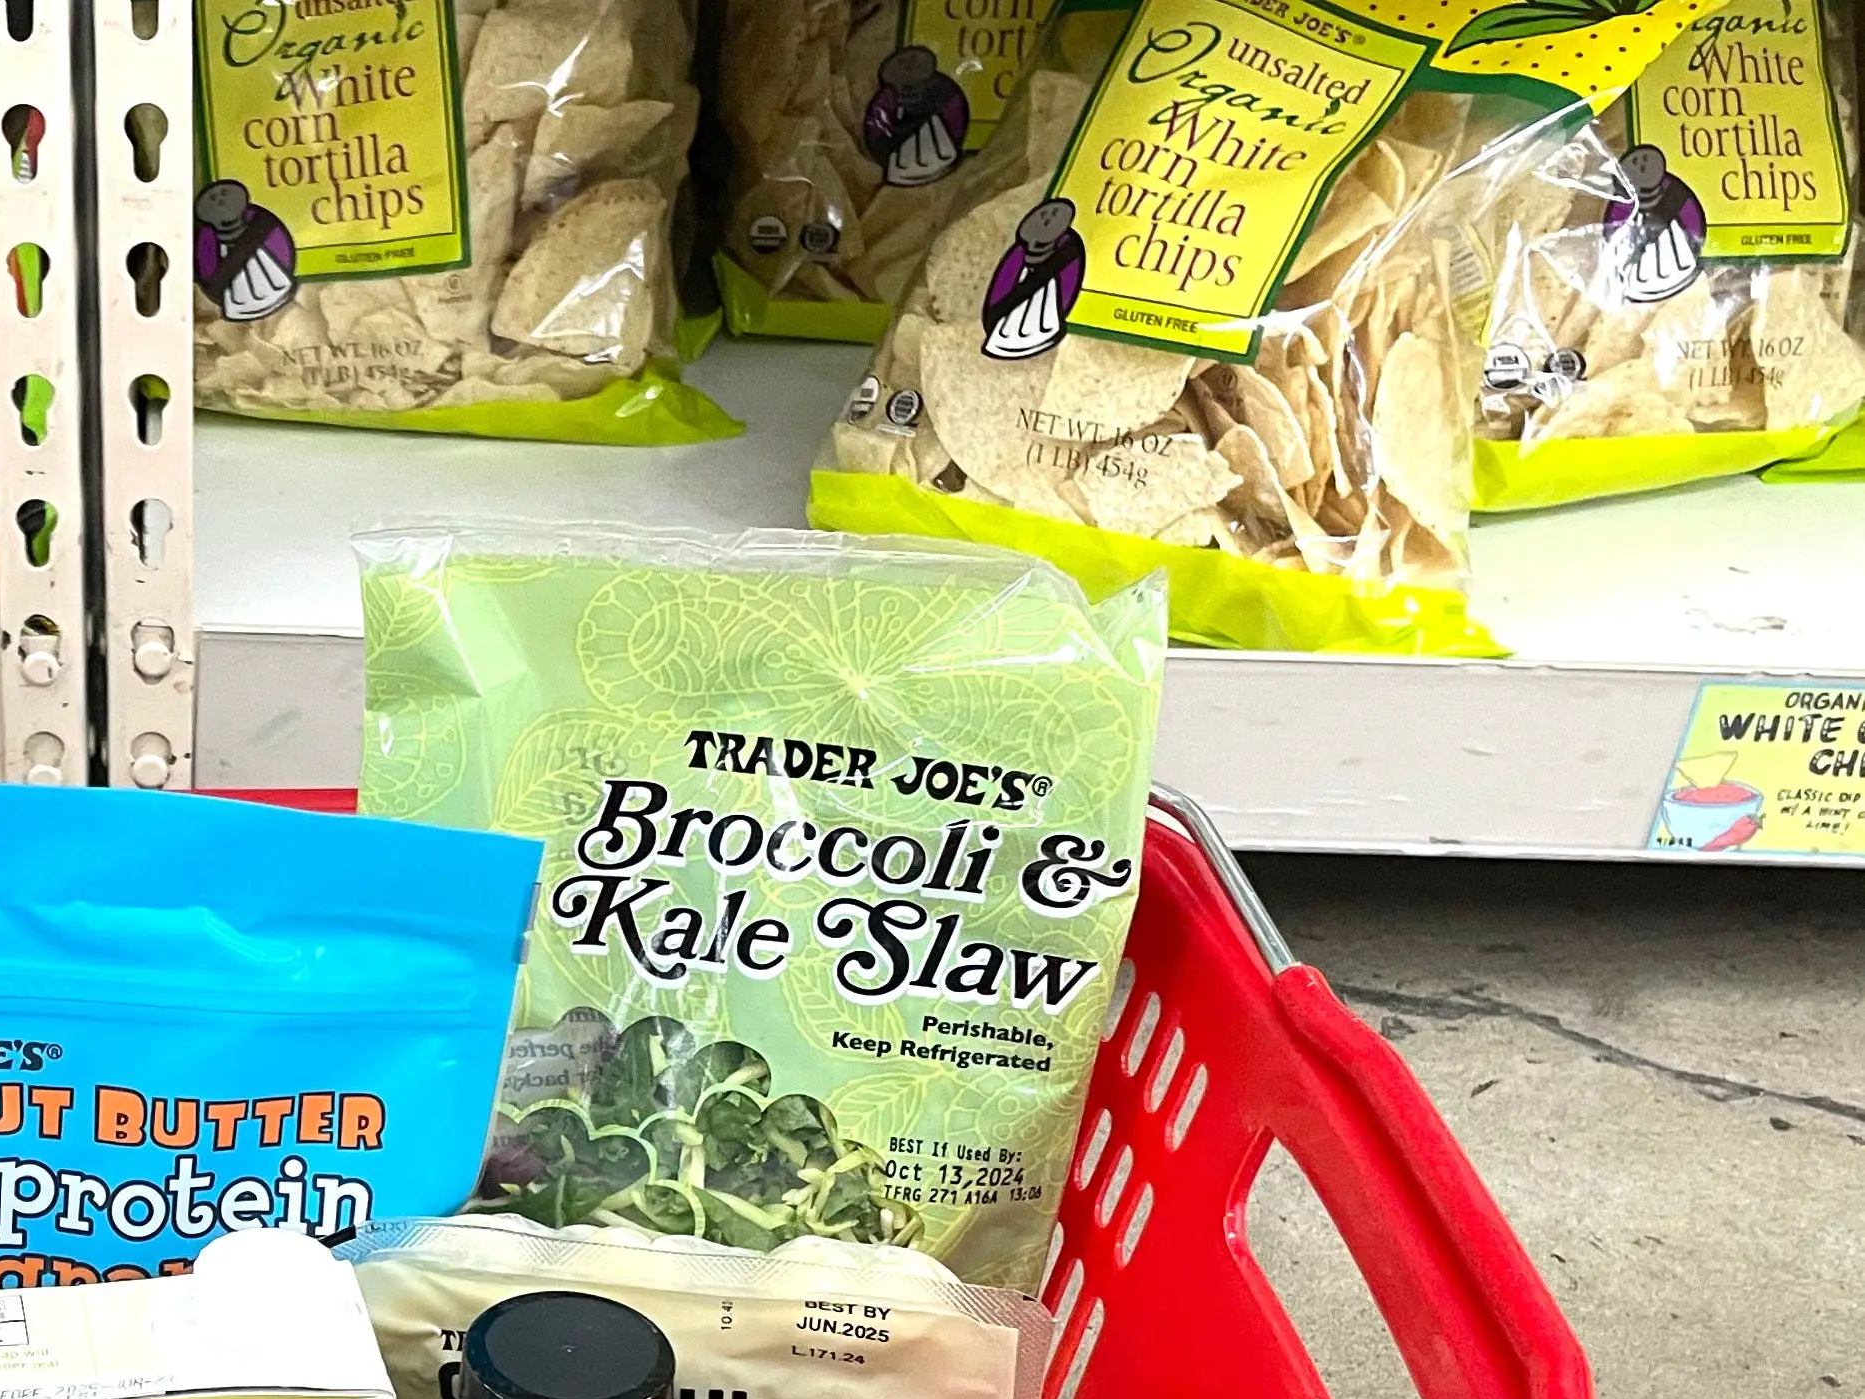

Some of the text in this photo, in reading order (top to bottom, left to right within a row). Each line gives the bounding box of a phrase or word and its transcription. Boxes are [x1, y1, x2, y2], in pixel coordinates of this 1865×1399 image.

[1129, 21, 1348, 137] Organic
[1227, 37, 1372, 105] unsalted
[1700, 42, 1804, 85] White
[285, 63, 416, 111] White
[1662, 85, 1744, 117] corn
[243, 107, 342, 150] corn
[1161, 103, 1308, 174] White
[1680, 115, 1802, 160] tortilla
[263, 137, 409, 189] tortilla
[1100, 135, 1199, 188] corn
[311, 178, 425, 232] chips
[1721, 158, 1817, 210] chips
[1095, 177, 1247, 238] tortilla
[1114, 222, 1242, 293] chips
[1741, 234, 1813, 246] GLUTEN FREE
[1113, 307, 1199, 334] GLUTEN FREE
[1758, 338, 1775, 357] 16
[1778, 336, 1805, 357] OZ
[1016, 407, 1064, 435] NET
[1096, 454, 1150, 489] 454g
[1785, 692, 1865, 711] ORGAN
[1720, 713, 1846, 743] WHITE
[686, 730, 875, 790] TRADER
[1776, 789, 1833, 803] CLASSIC
[578, 780, 1132, 910] Broccoli &
[553, 875, 1101, 1008] Kale Slaw
[832, 1031, 1051, 1072] Keep Refrigerated
[921, 1014, 1054, 1051] Perishable,
[92, 1088, 386, 1151] BUTTER
[890, 1136, 1022, 1165] BEST If Used By:
[884, 1159, 1025, 1190] Oct 13,2024
[929, 1189, 957, 1205] 271
[796, 1316, 890, 1343] JUN.2025
[863, 1305, 891, 1321] BY
